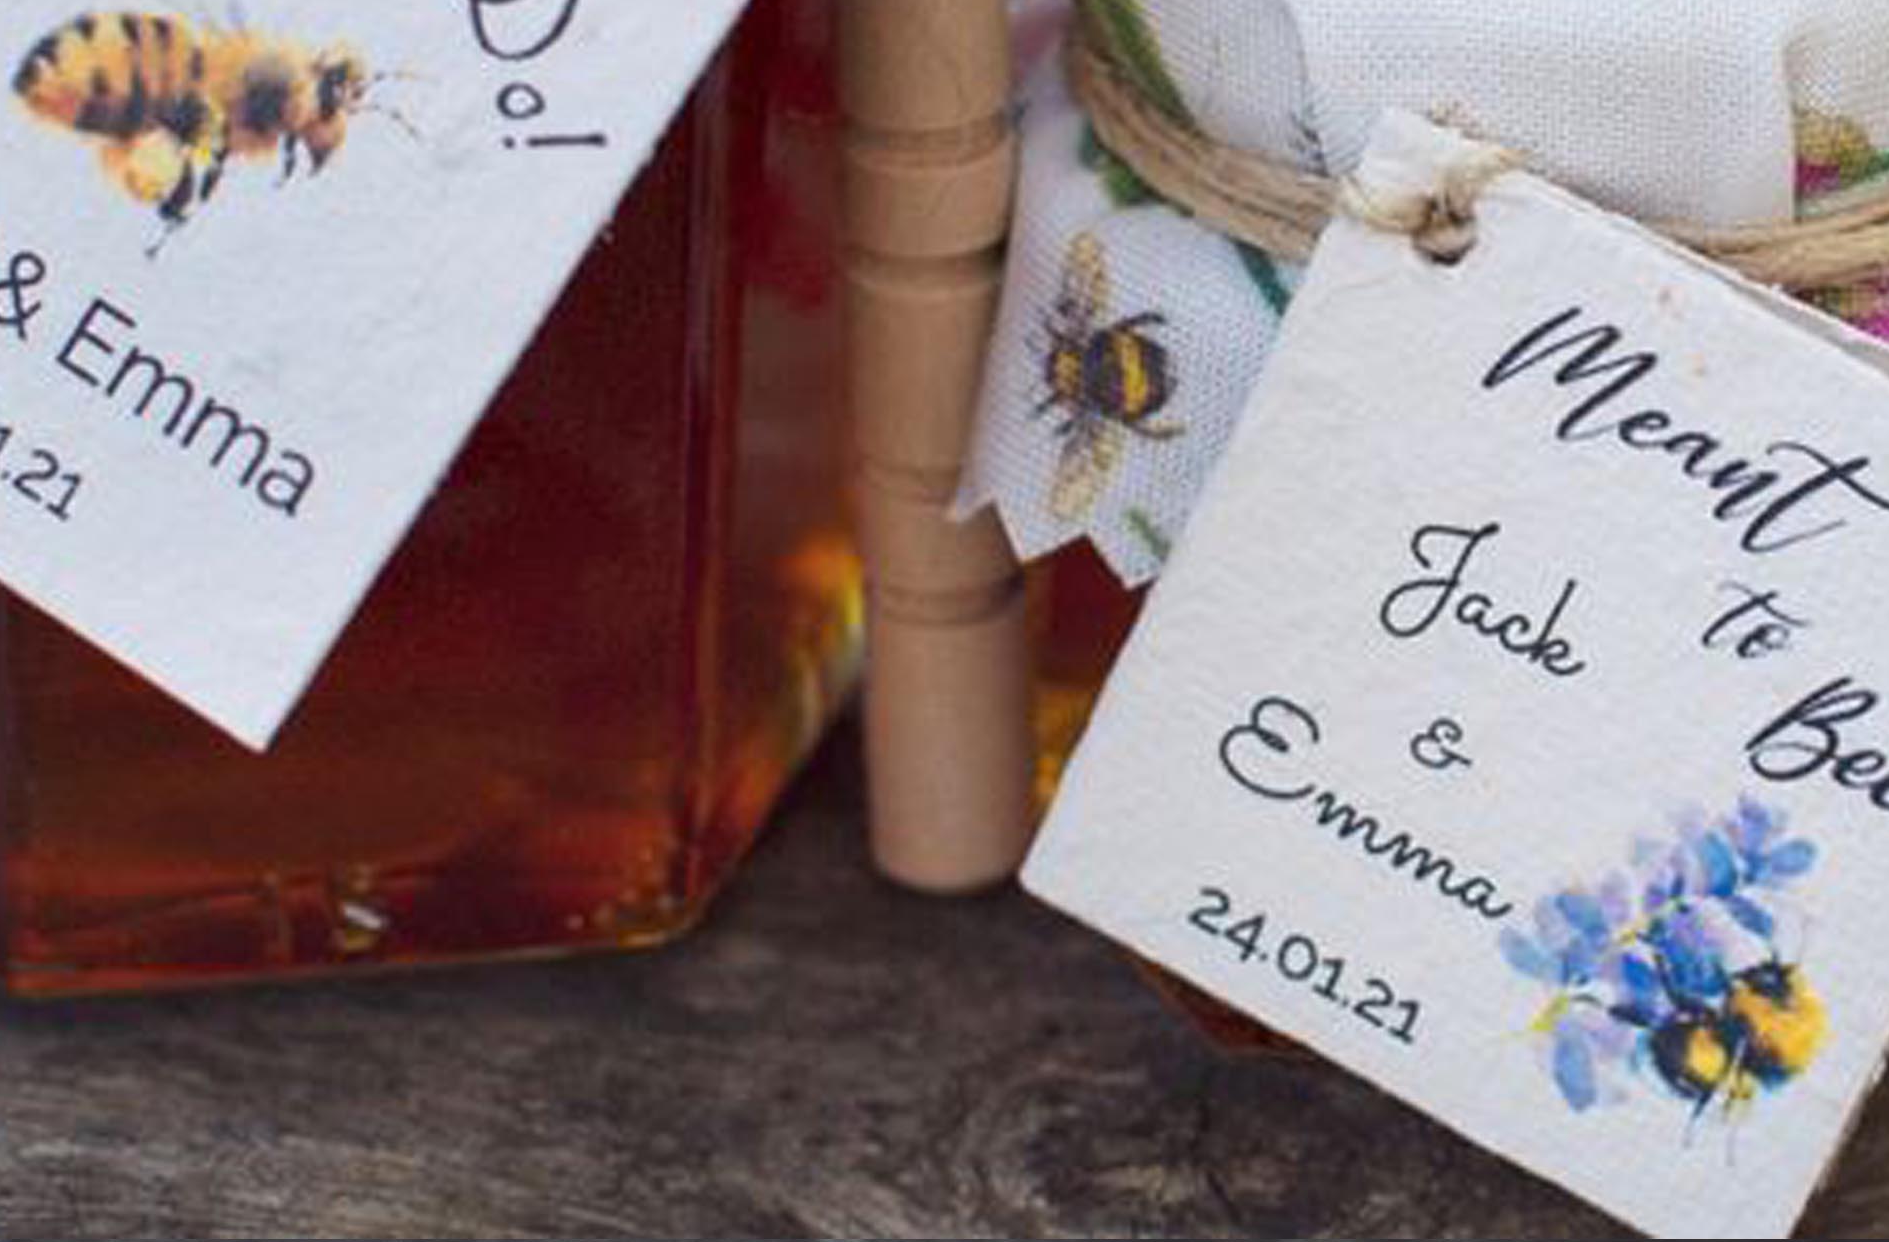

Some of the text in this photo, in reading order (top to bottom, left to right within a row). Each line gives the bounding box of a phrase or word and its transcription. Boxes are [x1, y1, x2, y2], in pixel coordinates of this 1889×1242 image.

[56, 299, 316, 518] Emma
[1379, 522, 1586, 677] Jack
[1700, 580, 1800, 660] to
[1219, 695, 1514, 920] Emma
[1410, 719, 1472, 770] &
[1187, 887, 1423, 1045] 24.01.21
